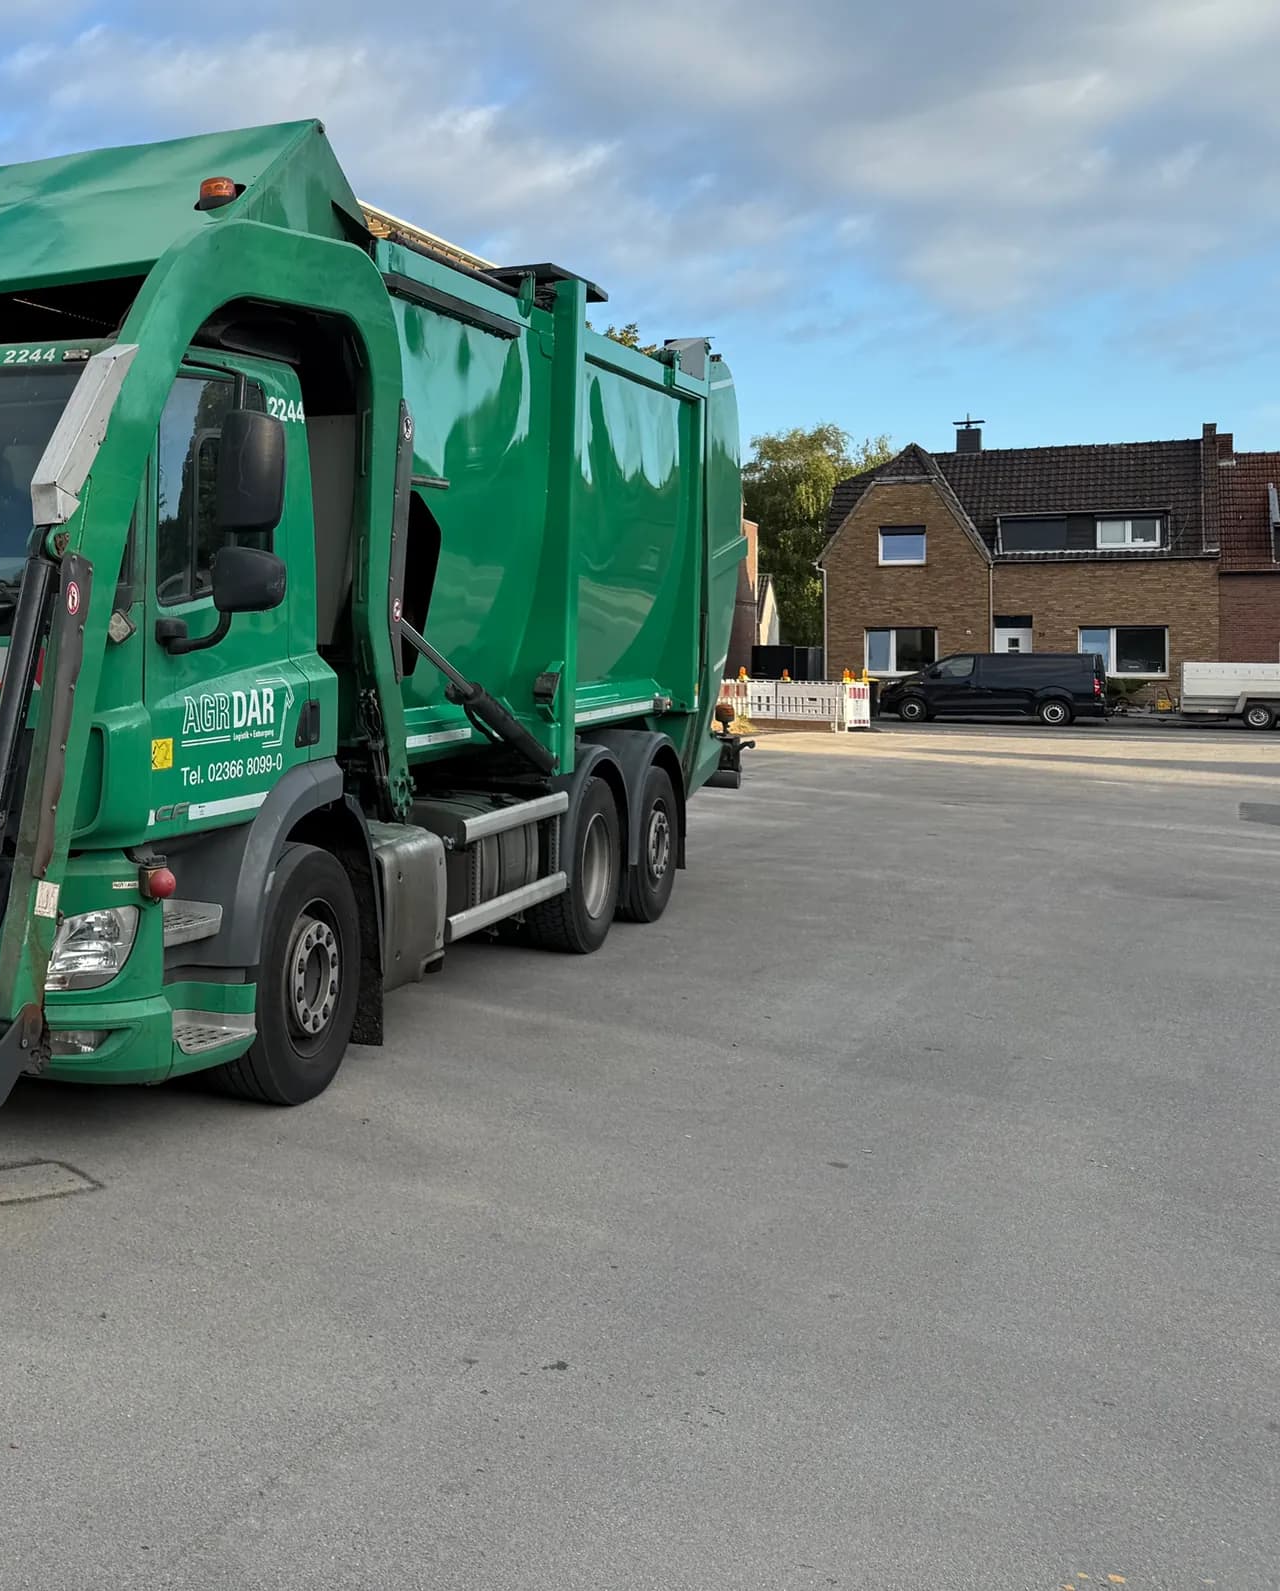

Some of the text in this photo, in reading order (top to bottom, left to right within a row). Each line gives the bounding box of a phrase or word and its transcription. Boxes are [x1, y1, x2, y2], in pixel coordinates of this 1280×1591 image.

[3, 347, 56, 364] 2244
[268, 396, 305, 424] 2244
[182, 687, 275, 735] AGR DAR
[181, 753, 283, 786] Tel. 02366 8099-0
[156, 801, 191, 821] CF
